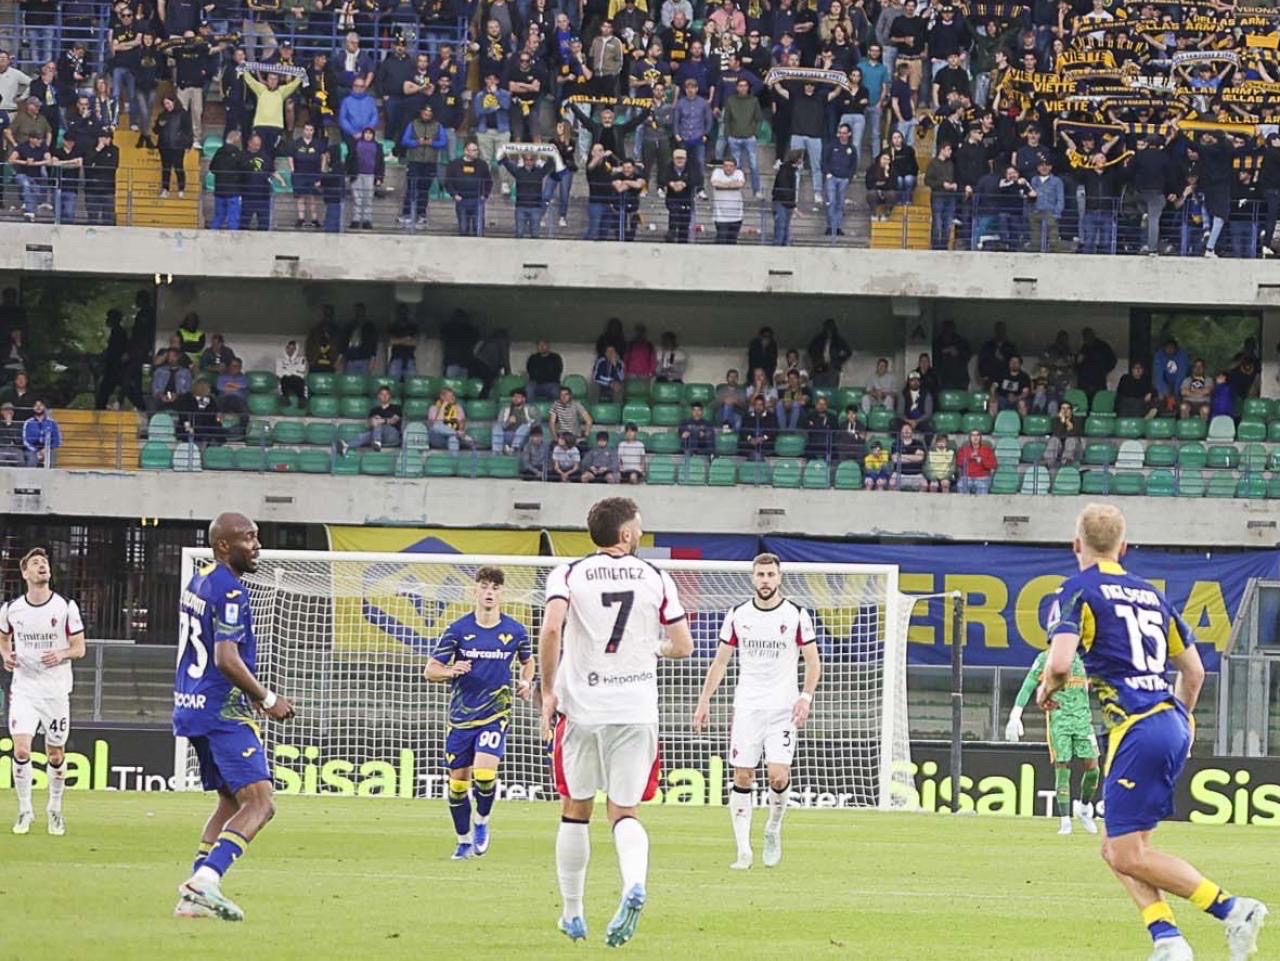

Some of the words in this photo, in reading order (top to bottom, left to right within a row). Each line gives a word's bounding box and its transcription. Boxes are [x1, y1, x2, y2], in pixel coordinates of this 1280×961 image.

[1062, 50, 1106, 63] VIETTE
[1032, 82, 1077, 93] VIETTE
[1044, 99, 1090, 112] VIETTE
[585, 566, 647, 581] GIMENEZ
[601, 590, 635, 654] 7
[17, 630, 59, 643] Emirates
[742, 638, 788, 651] Emirates
[1114, 604, 1168, 674] 15
[465, 648, 505, 660] aircash
[49, 716, 68, 733] 46
[478, 730, 502, 749] 90
[782, 729, 792, 748] 3
[0, 739, 109, 792] isal
[274, 743, 415, 798] Sisal
[418, 773, 544, 802] Titer
[891, 760, 1035, 818] Sisal
